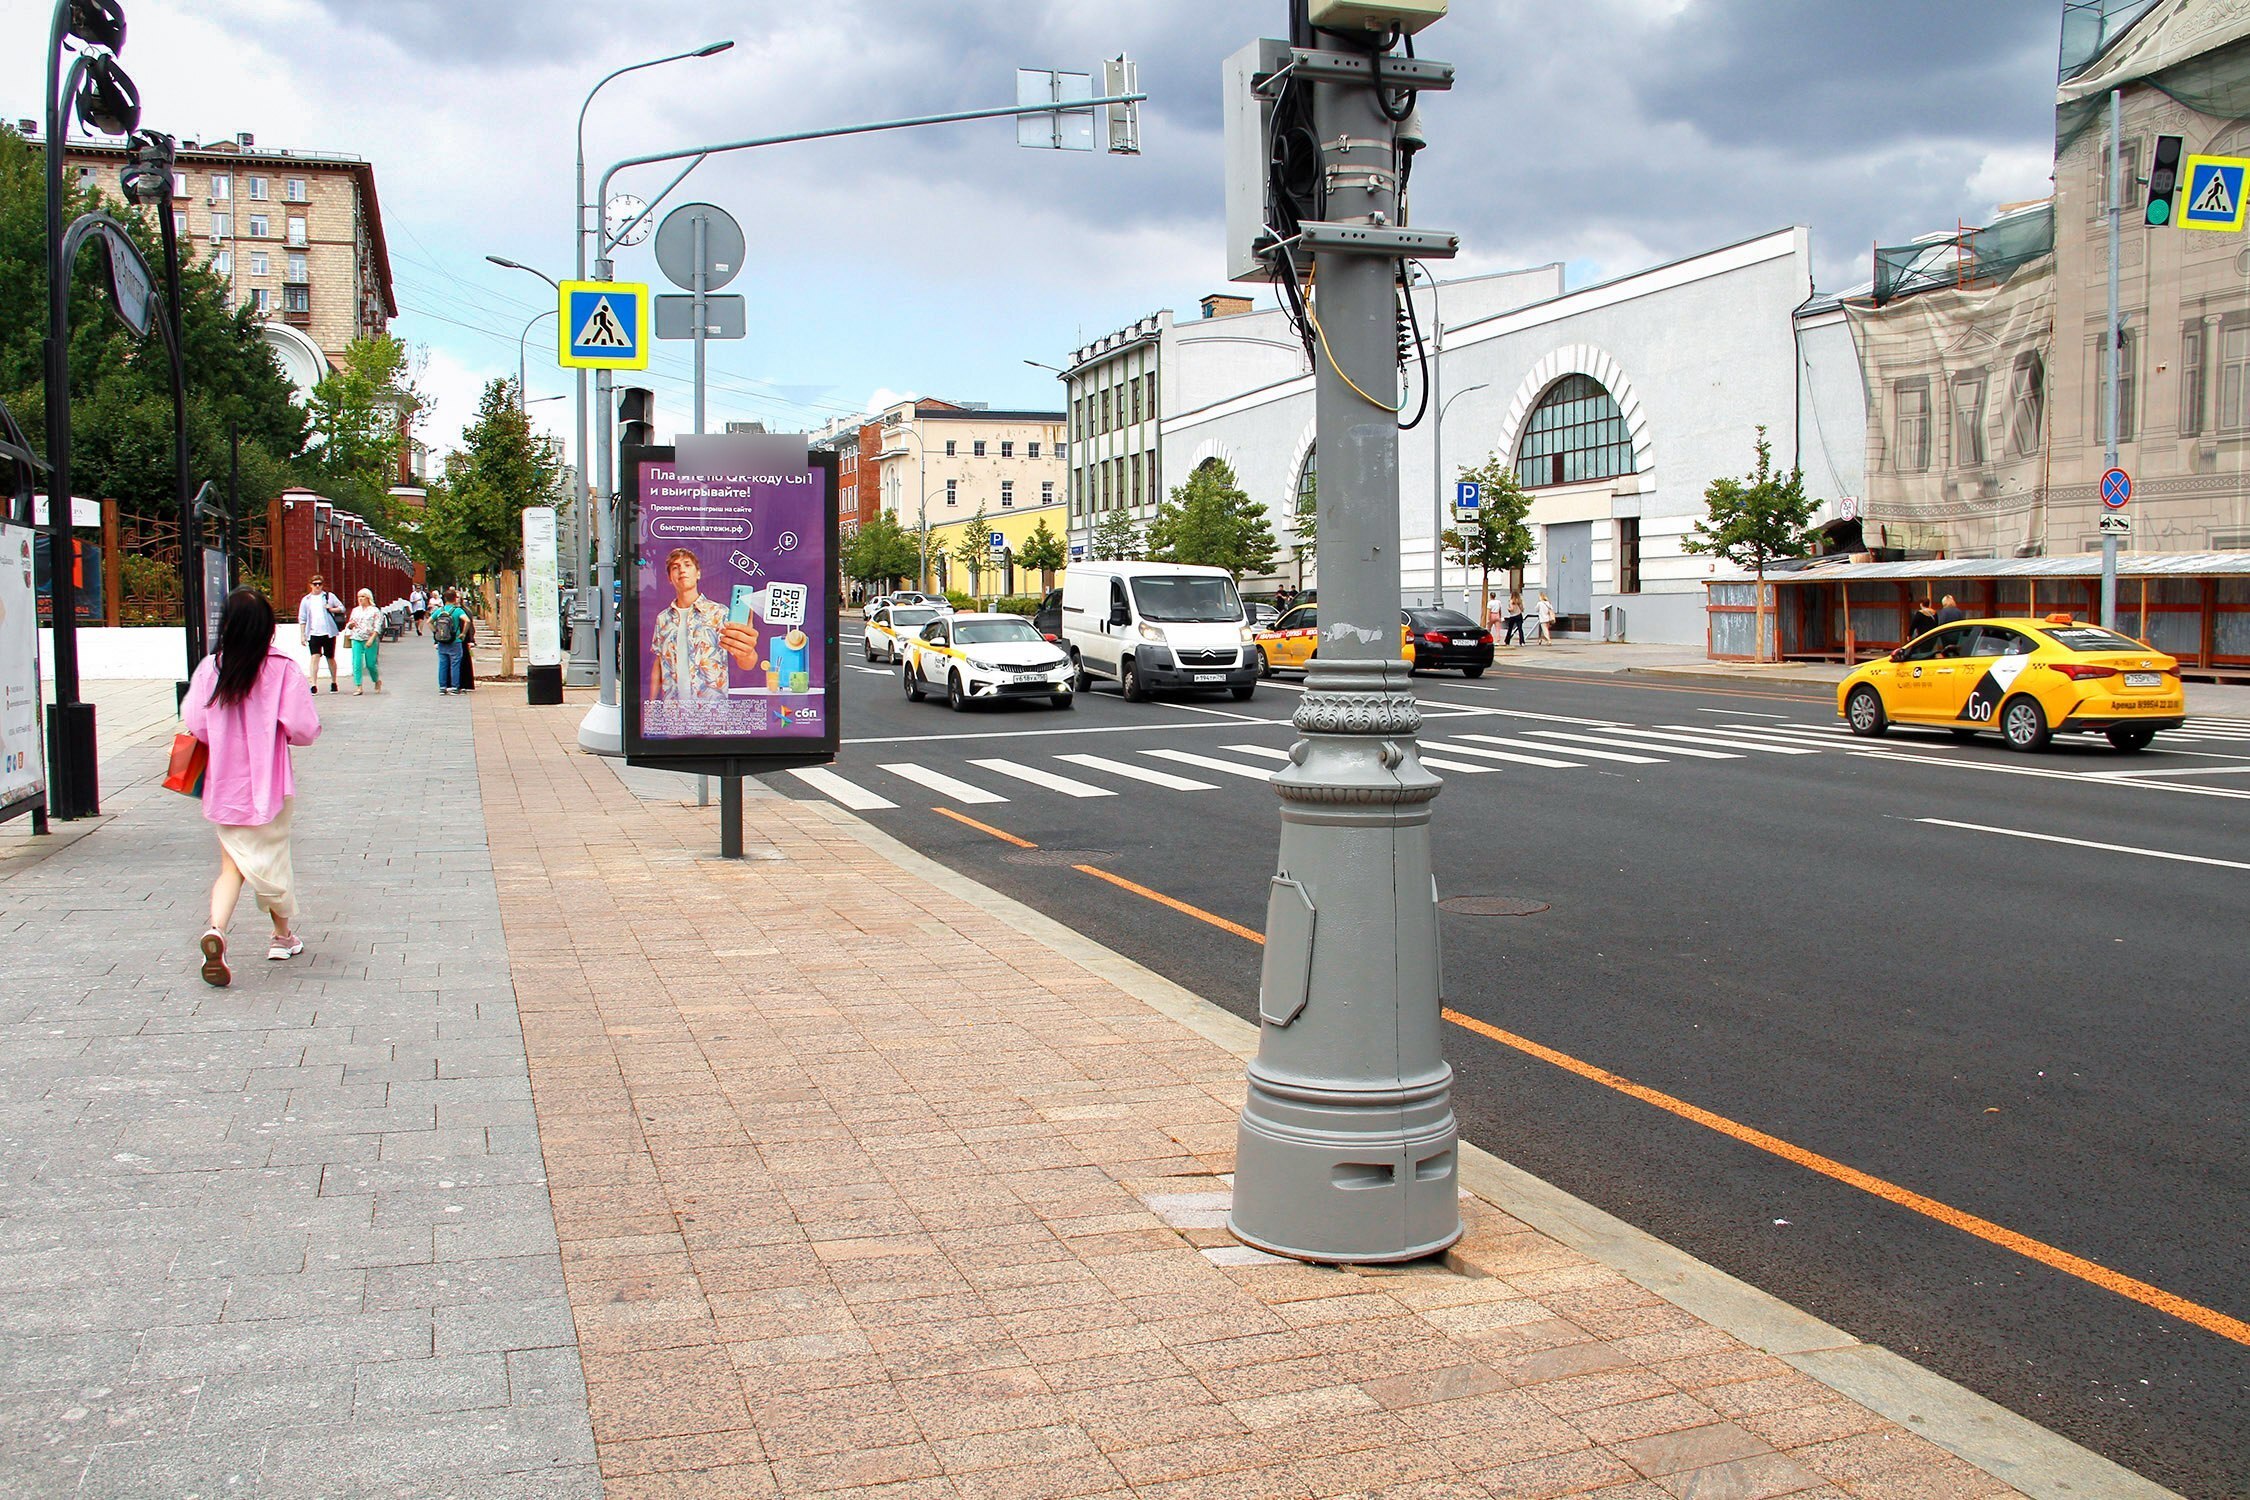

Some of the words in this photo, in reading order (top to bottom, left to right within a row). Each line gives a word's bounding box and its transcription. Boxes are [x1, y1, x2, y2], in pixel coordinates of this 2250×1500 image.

[662, 486, 752, 500] выигрывайте!
[1463, 485, 1476, 505] P
[650, 504, 692, 512] Проверяйте
[660, 523, 744, 534] быстрыеплатежи.рф
[994, 534, 1002, 544] P
[1969, 692, 1990, 722] Go
[2112, 701, 2136, 710] Аренда
[795, 708, 816, 718] сбп
